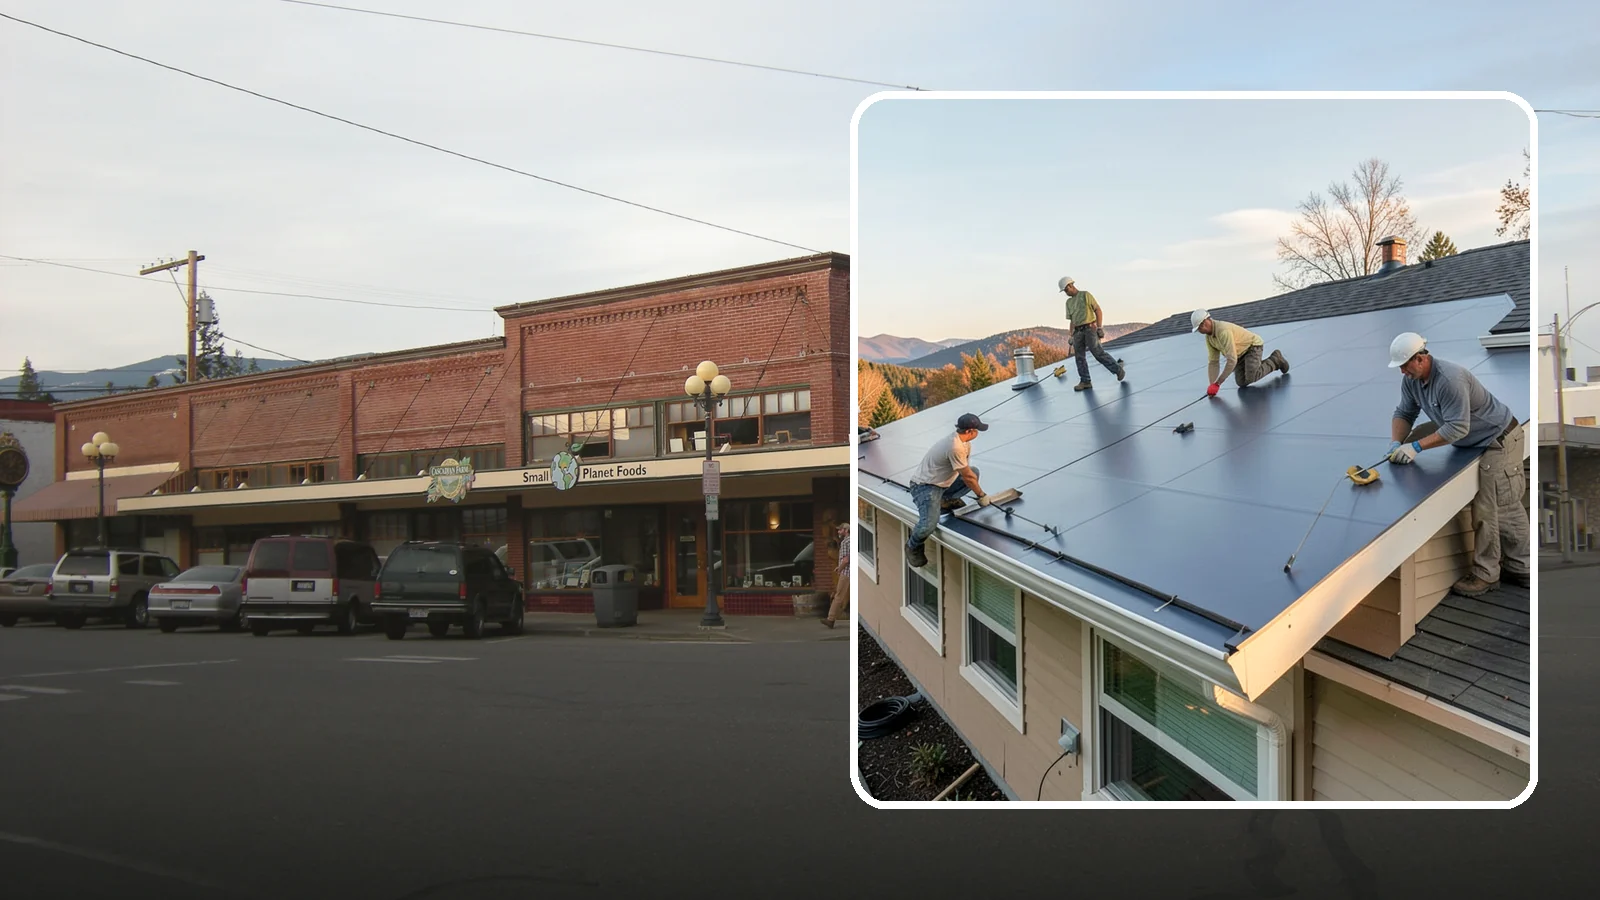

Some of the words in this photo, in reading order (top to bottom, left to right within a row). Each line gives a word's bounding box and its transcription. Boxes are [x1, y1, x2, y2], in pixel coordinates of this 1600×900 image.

[523, 471, 549, 483] Small
[582, 467, 614, 479] Planet
[616, 464, 647, 477] Foods
